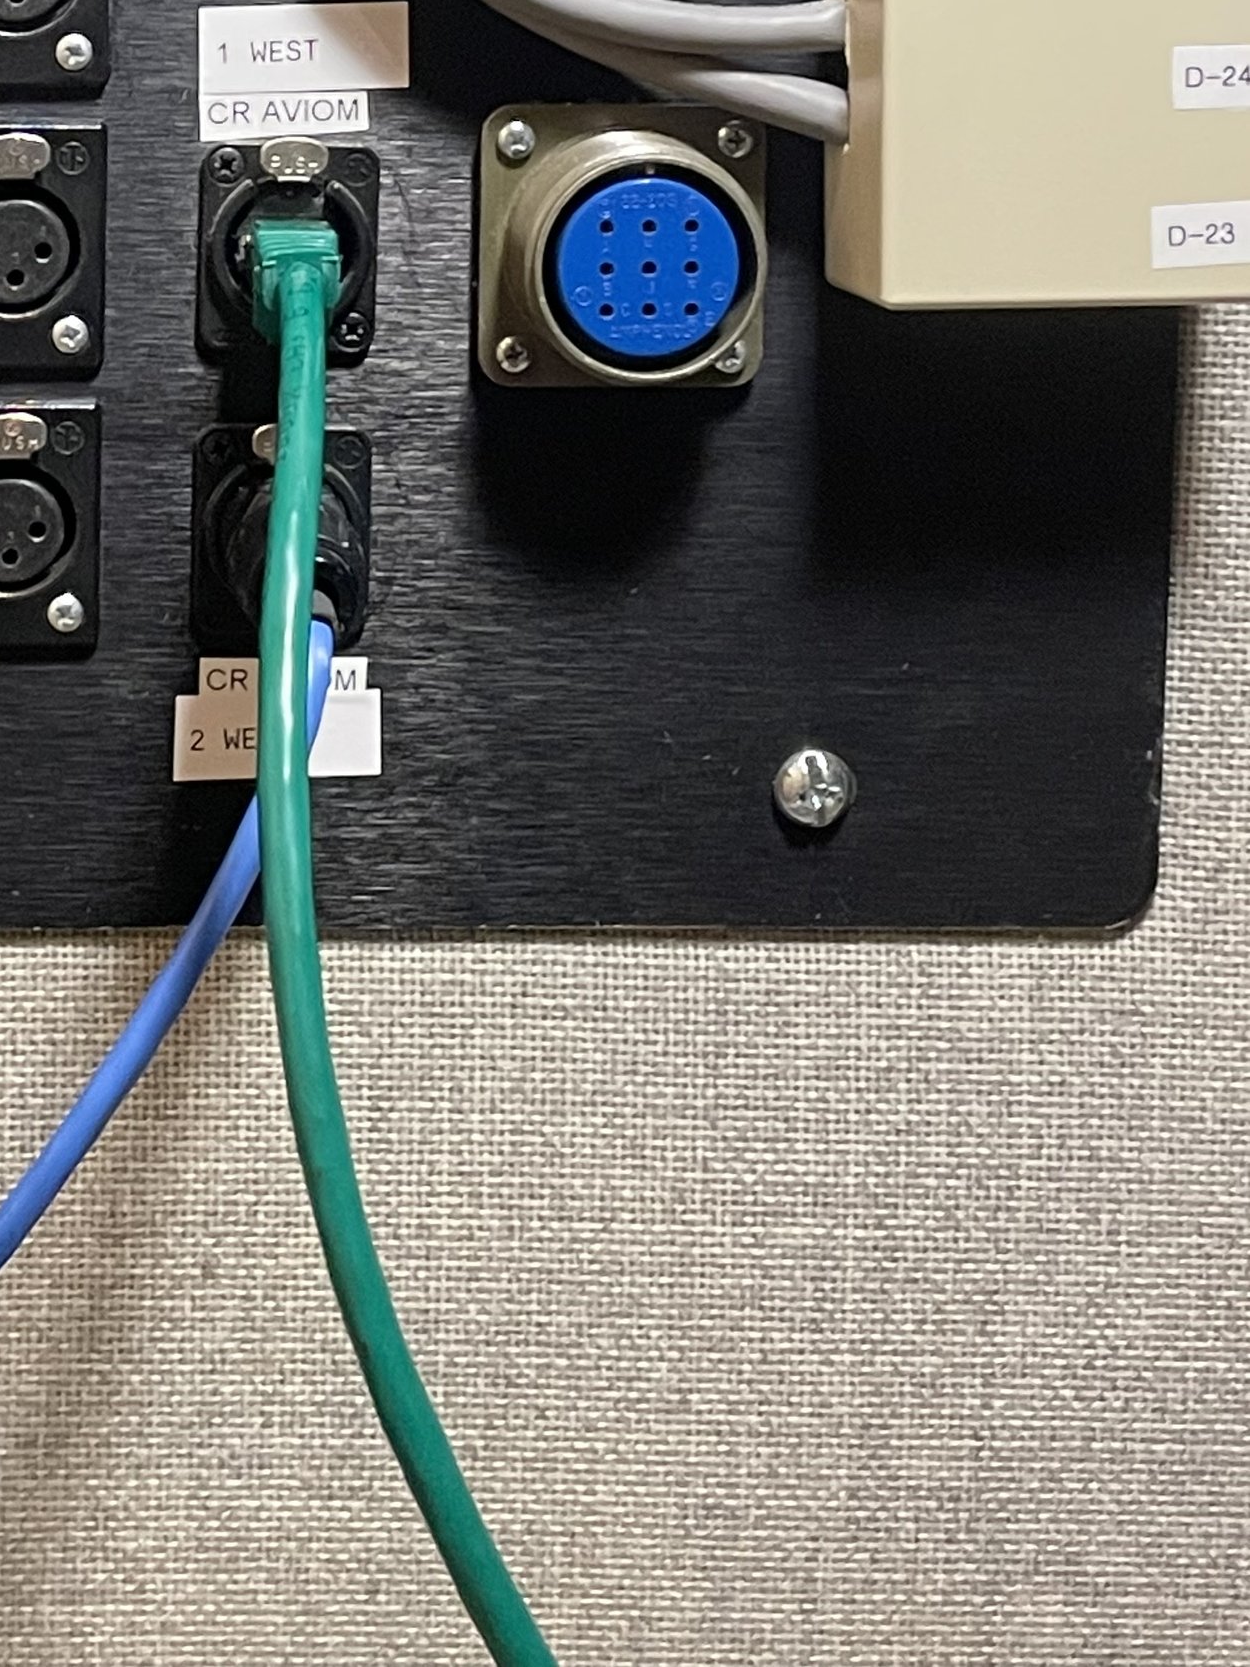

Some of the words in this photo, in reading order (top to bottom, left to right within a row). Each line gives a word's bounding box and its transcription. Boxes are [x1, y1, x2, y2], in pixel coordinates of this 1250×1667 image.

[217, 42, 228, 64] 1
[250, 38, 319, 63] WEST
[1184, 65, 1250, 88] D-24
[207, 100, 250, 125] CR
[261, 98, 359, 123] AVIOM
[1167, 222, 1236, 247] D-23
[206, 668, 249, 691] CR
[189, 729, 205, 752] 2
[223, 727, 258, 751] WE
